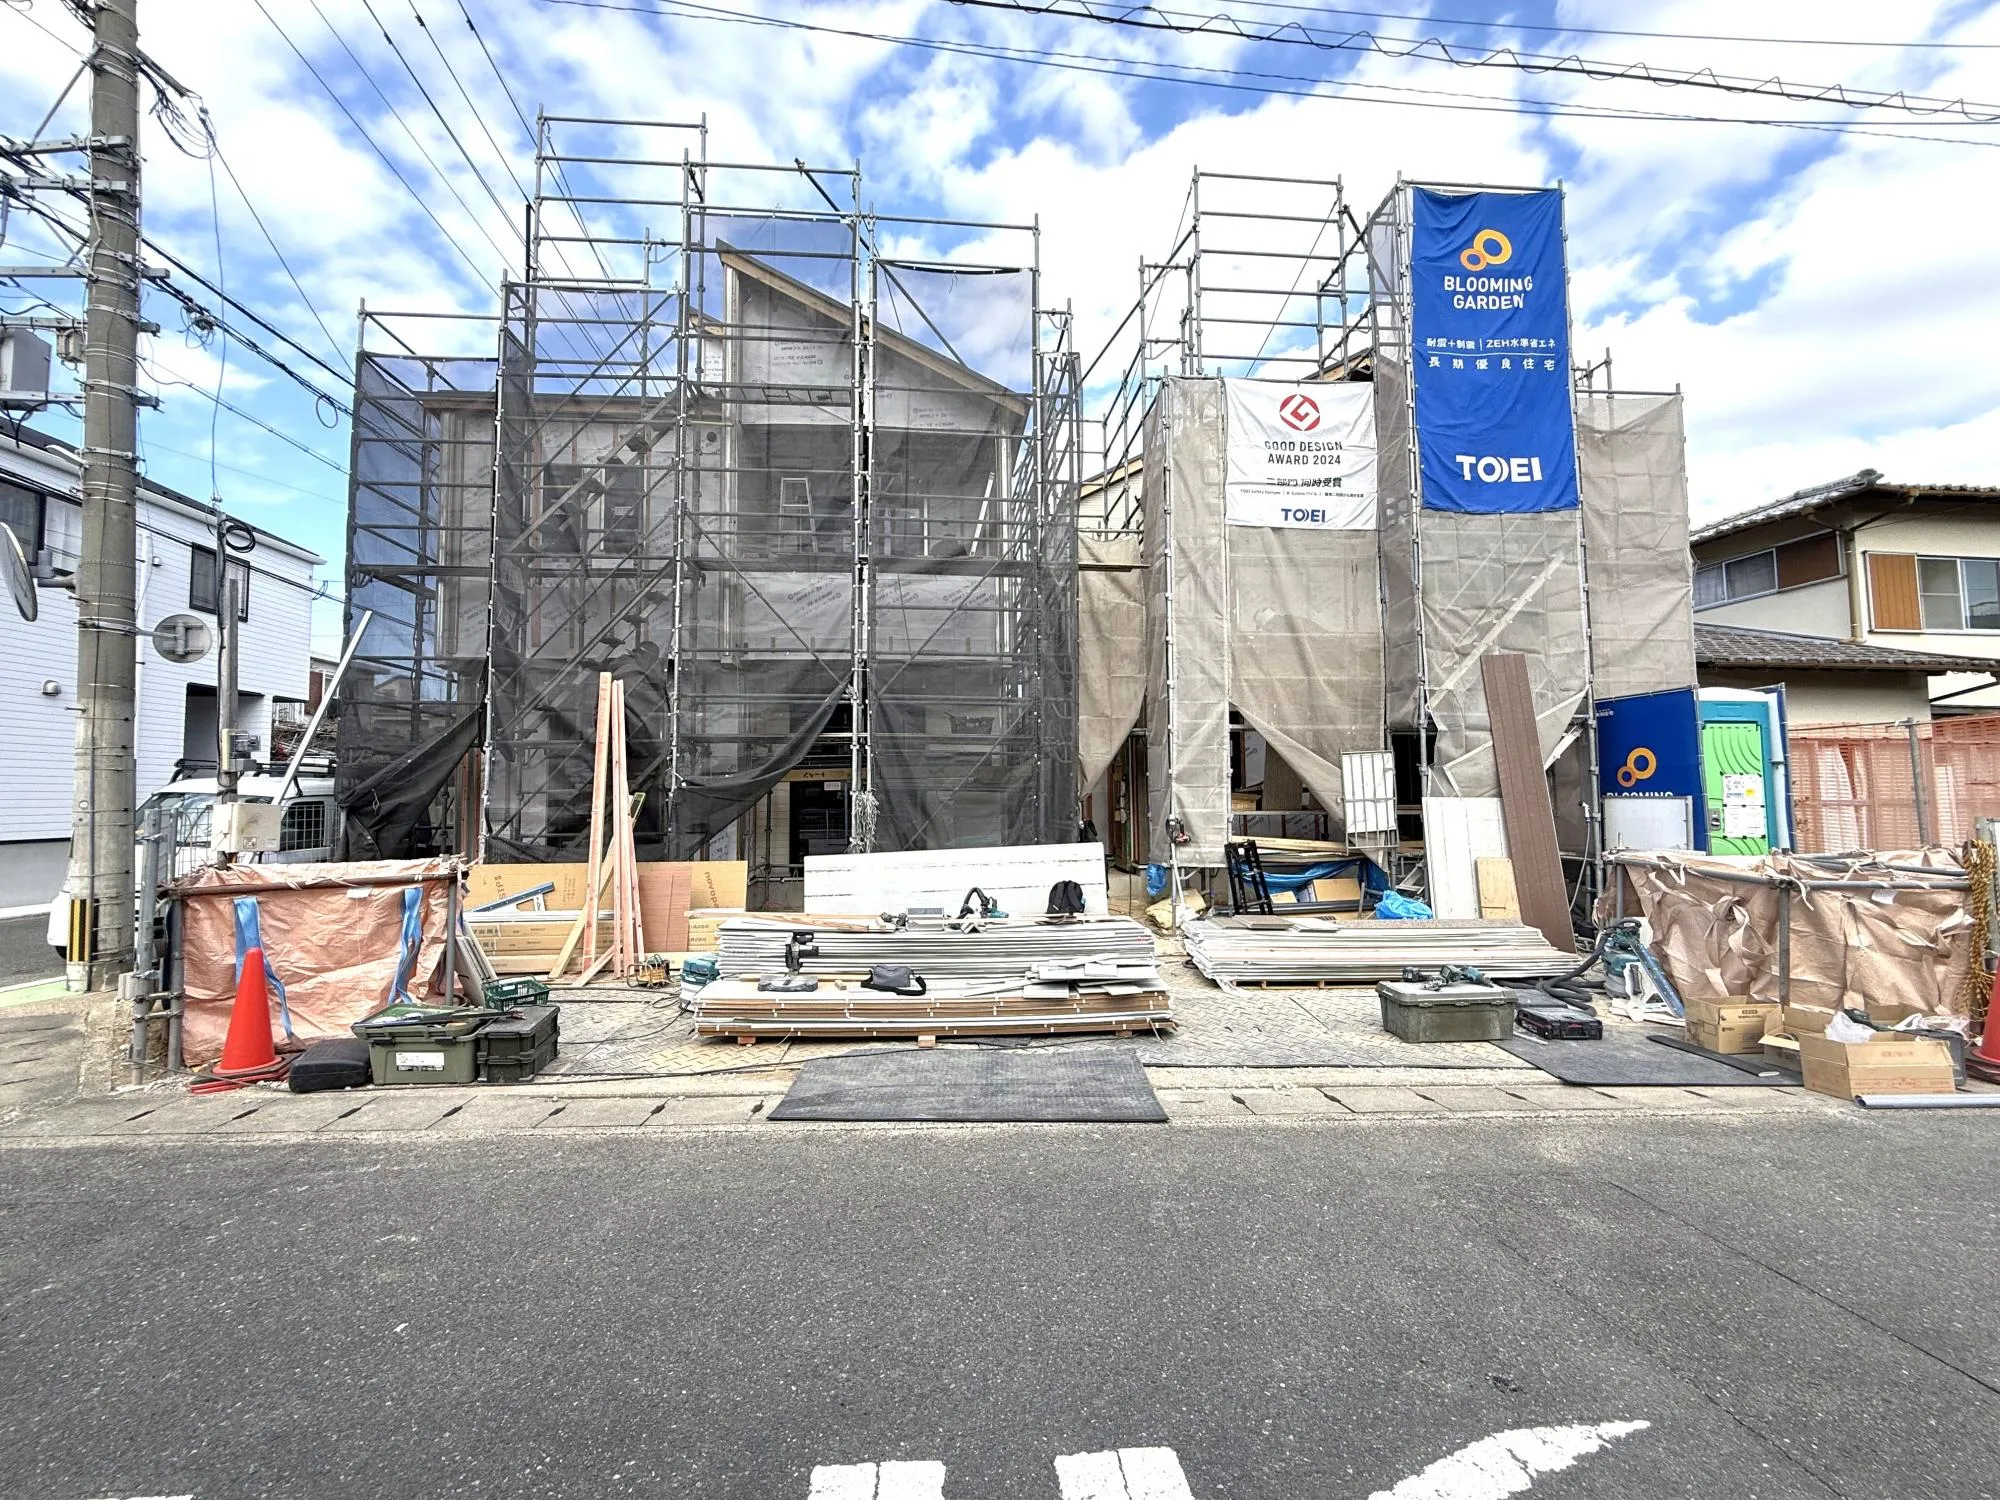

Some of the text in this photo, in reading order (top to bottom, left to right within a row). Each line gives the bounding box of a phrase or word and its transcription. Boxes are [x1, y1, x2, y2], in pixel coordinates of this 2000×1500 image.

[1444, 275, 1533, 293] BLOOMING
[1453, 293, 1525, 309] GARDEN
[1264, 441, 1343, 452] GOOD DESIGN
[1267, 453, 1342, 465] AWARD 2024
[1456, 454, 1543, 483] TOEI
[1281, 508, 1326, 522] TOEI
